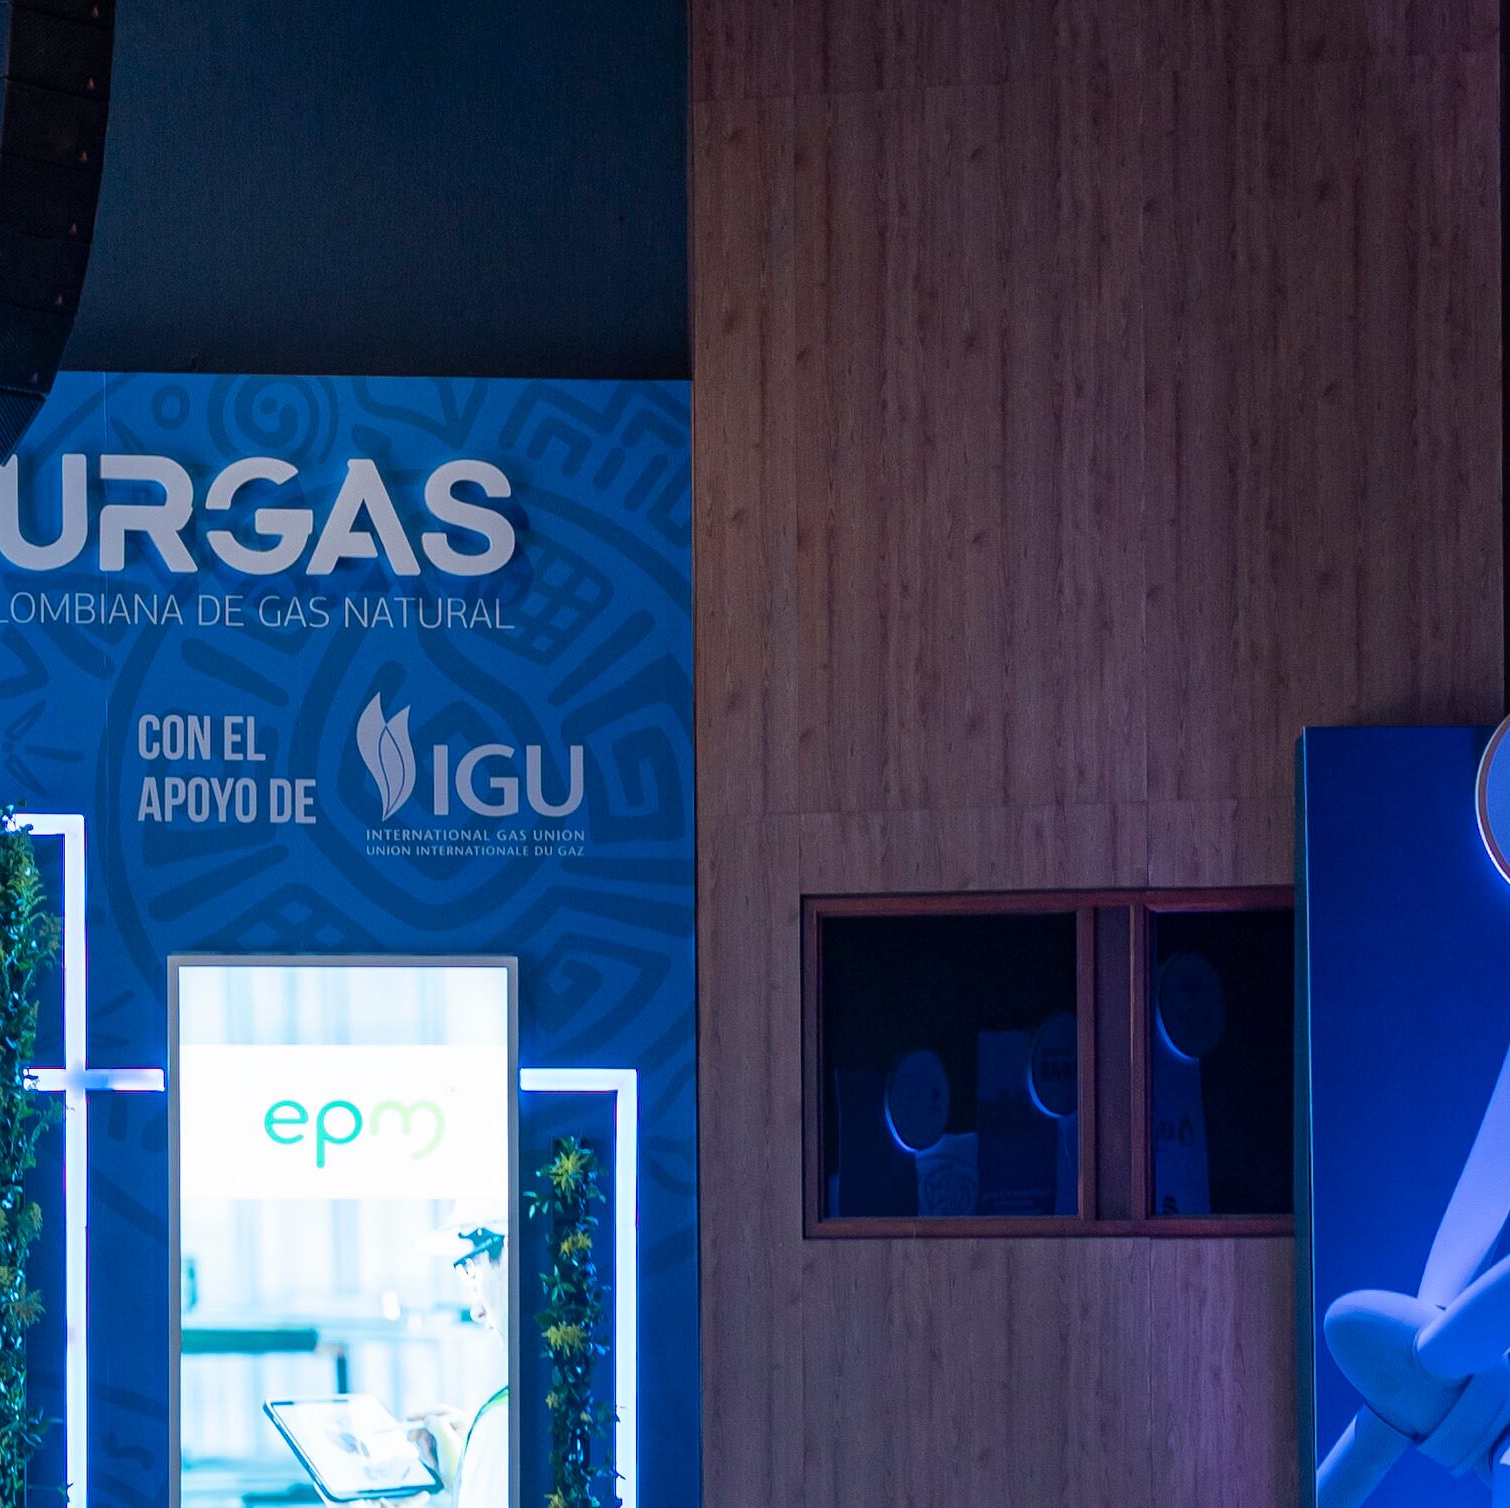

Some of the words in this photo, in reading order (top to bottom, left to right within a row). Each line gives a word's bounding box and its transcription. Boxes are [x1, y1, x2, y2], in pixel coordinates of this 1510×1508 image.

[198, 594, 243, 627] DE
[259, 595, 330, 629] GAS
[343, 595, 515, 631] NATURAL
[138, 714, 211, 761] CON
[224, 716, 266, 762] EL
[137, 776, 261, 823] APOYO
[270, 778, 316, 824] DE
[433, 743, 585, 818] IGU
[366, 829, 490, 841] INTERNATIONAL
[496, 829, 527, 841] GAS
[533, 829, 585, 841] UNION
[366, 845, 411, 856] UNION
[416, 845, 529, 857] INTERNATIONALE
[535, 845, 553, 857] DU
[558, 845, 585, 857] GAZ
[264, 1100, 446, 1169] epm
